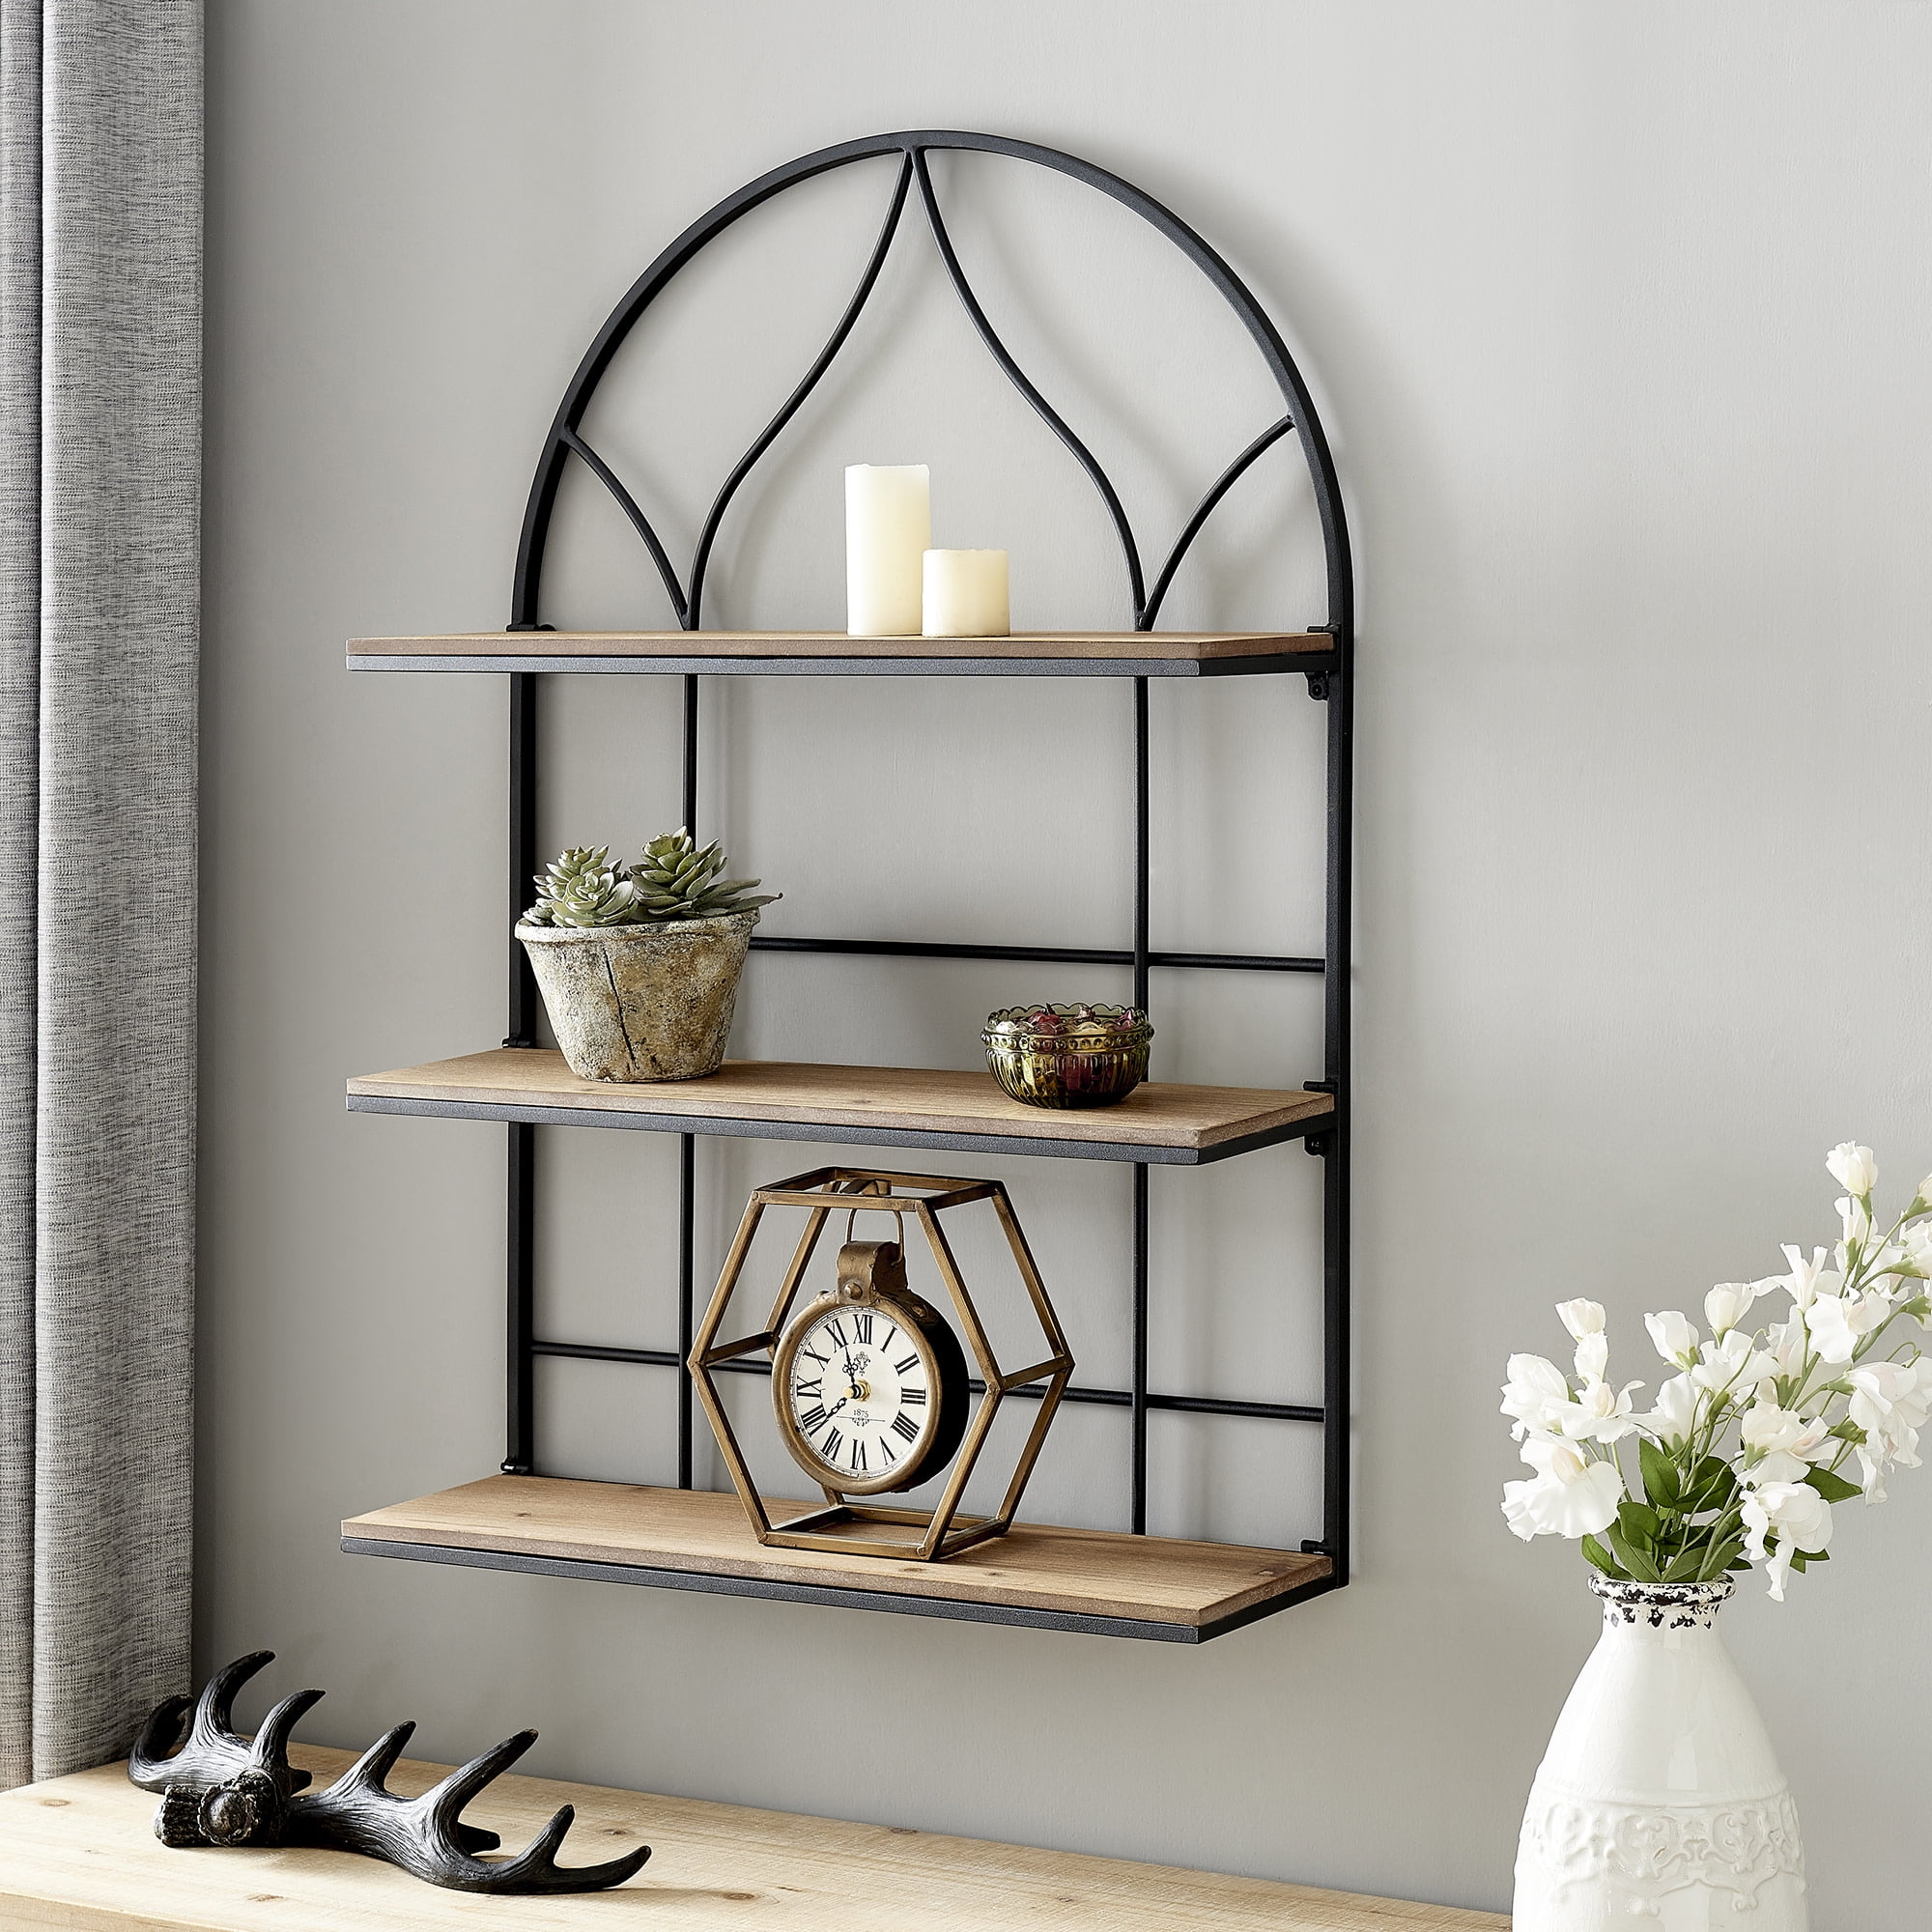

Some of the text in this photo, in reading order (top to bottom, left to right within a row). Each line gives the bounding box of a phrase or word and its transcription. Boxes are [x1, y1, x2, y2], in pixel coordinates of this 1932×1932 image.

[824, 1319, 849, 1352] XI
[853, 1315, 873, 1345] XII
[880, 1326, 897, 1352] I
[803, 1342, 831, 1372] X
[894, 1352, 921, 1376] II
[796, 1376, 822, 1399] IX
[901, 1386, 926, 1406] III
[853, 1408, 869, 1418] 1875
[820, 1426, 844, 1462] VII
[850, 1439, 867, 1470] VI
[879, 1435, 896, 1465] V
